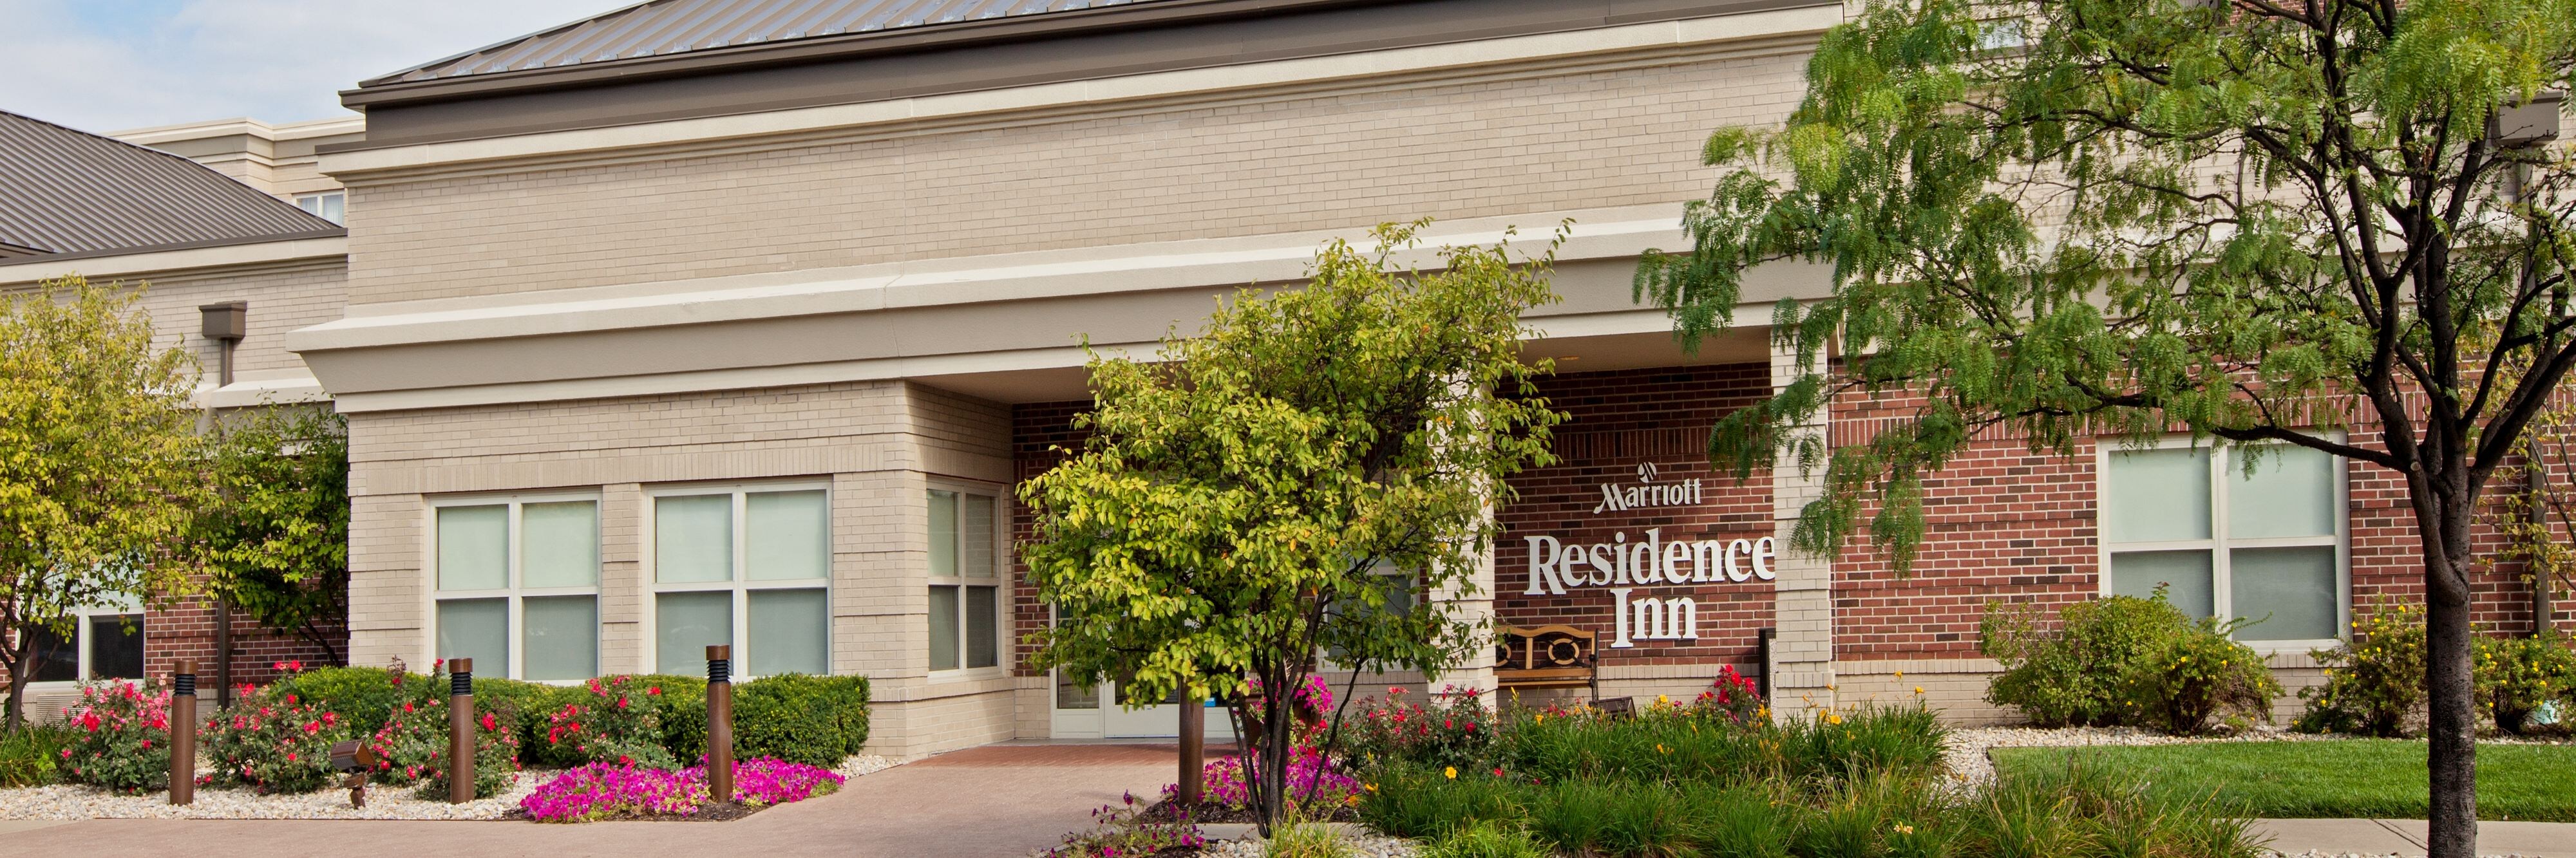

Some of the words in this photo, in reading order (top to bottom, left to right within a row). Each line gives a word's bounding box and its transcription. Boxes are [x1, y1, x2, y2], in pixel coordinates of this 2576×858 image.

[1593, 478, 1701, 514] Marriott
[1523, 527, 1775, 595] Residence
[1611, 588, 1699, 648] Inn
